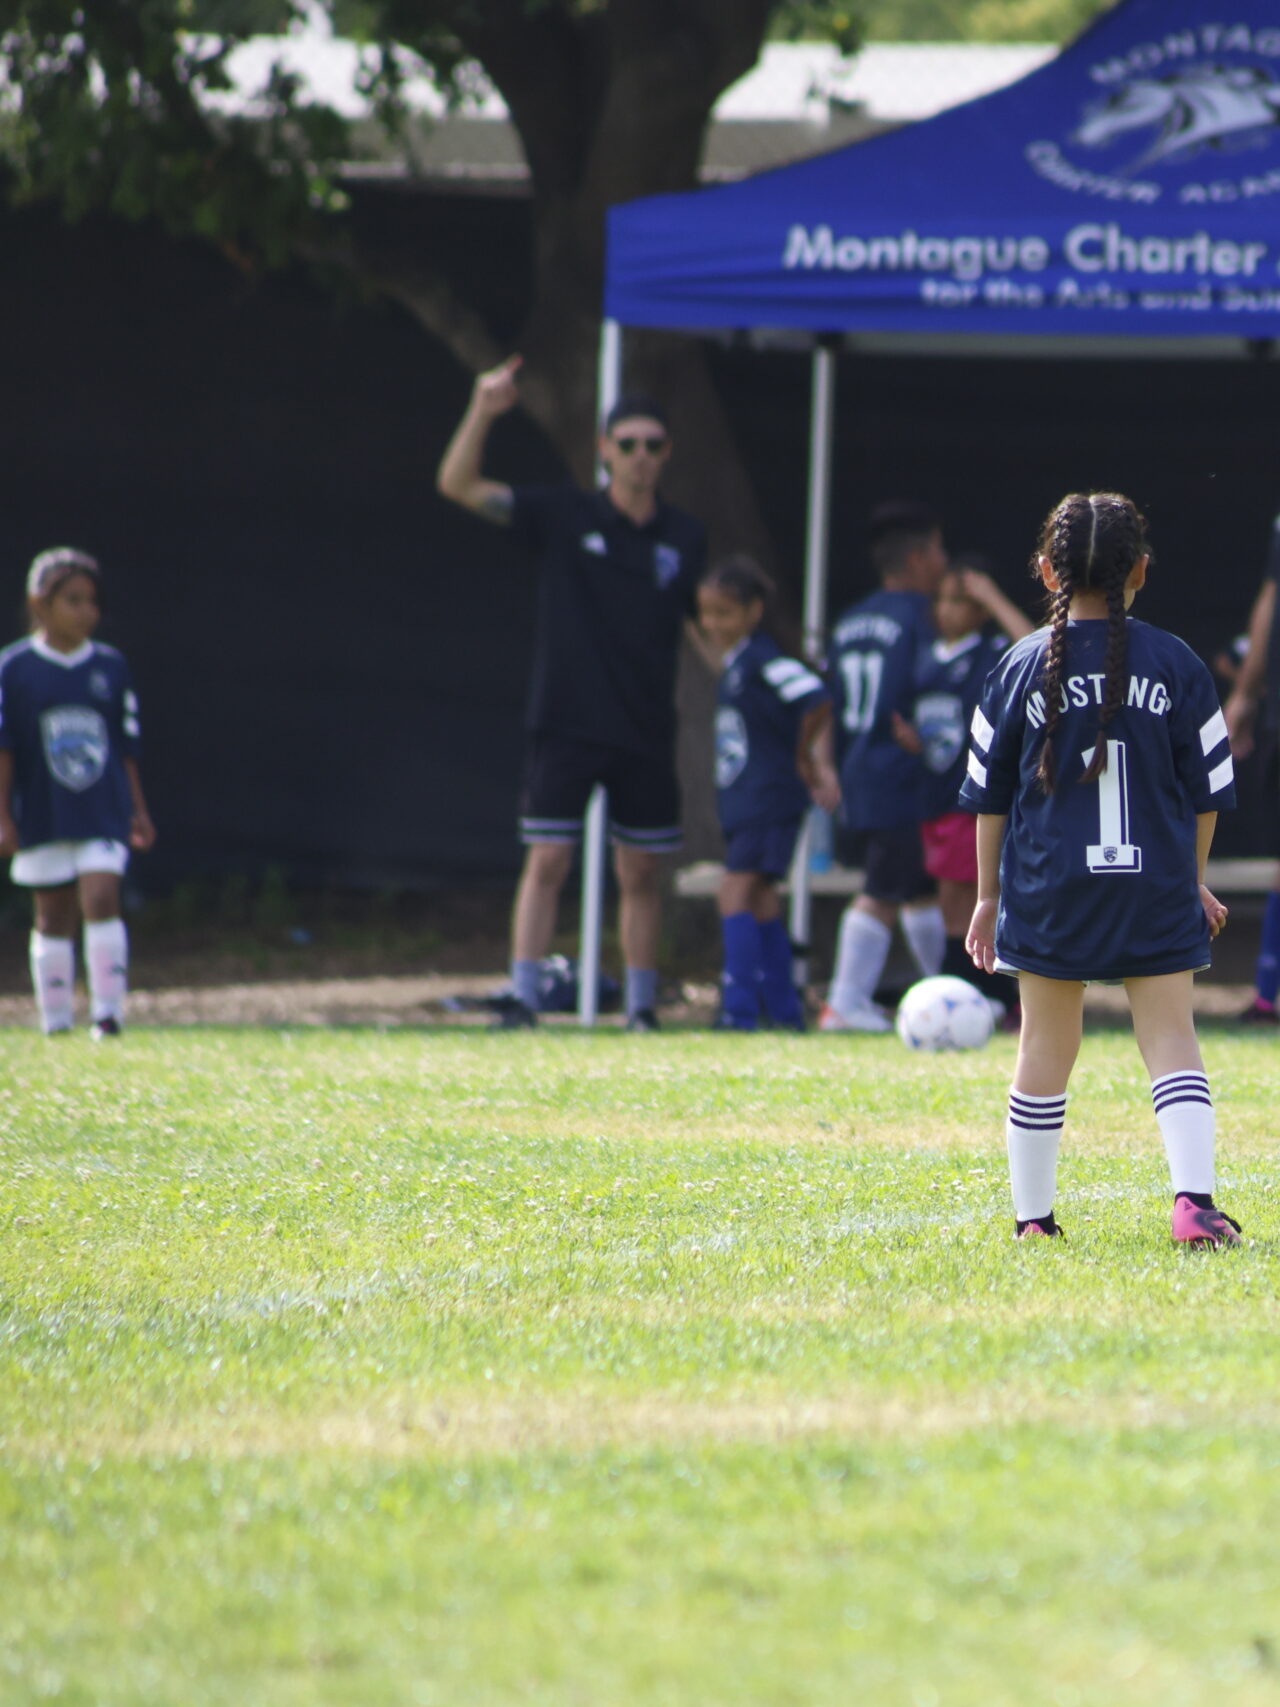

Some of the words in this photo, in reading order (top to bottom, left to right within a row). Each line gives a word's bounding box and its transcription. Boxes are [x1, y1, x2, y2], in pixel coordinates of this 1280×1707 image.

[784, 224, 1049, 281] Montague
[1063, 224, 1267, 276] Charter
[1081, 739, 1142, 873] 1
